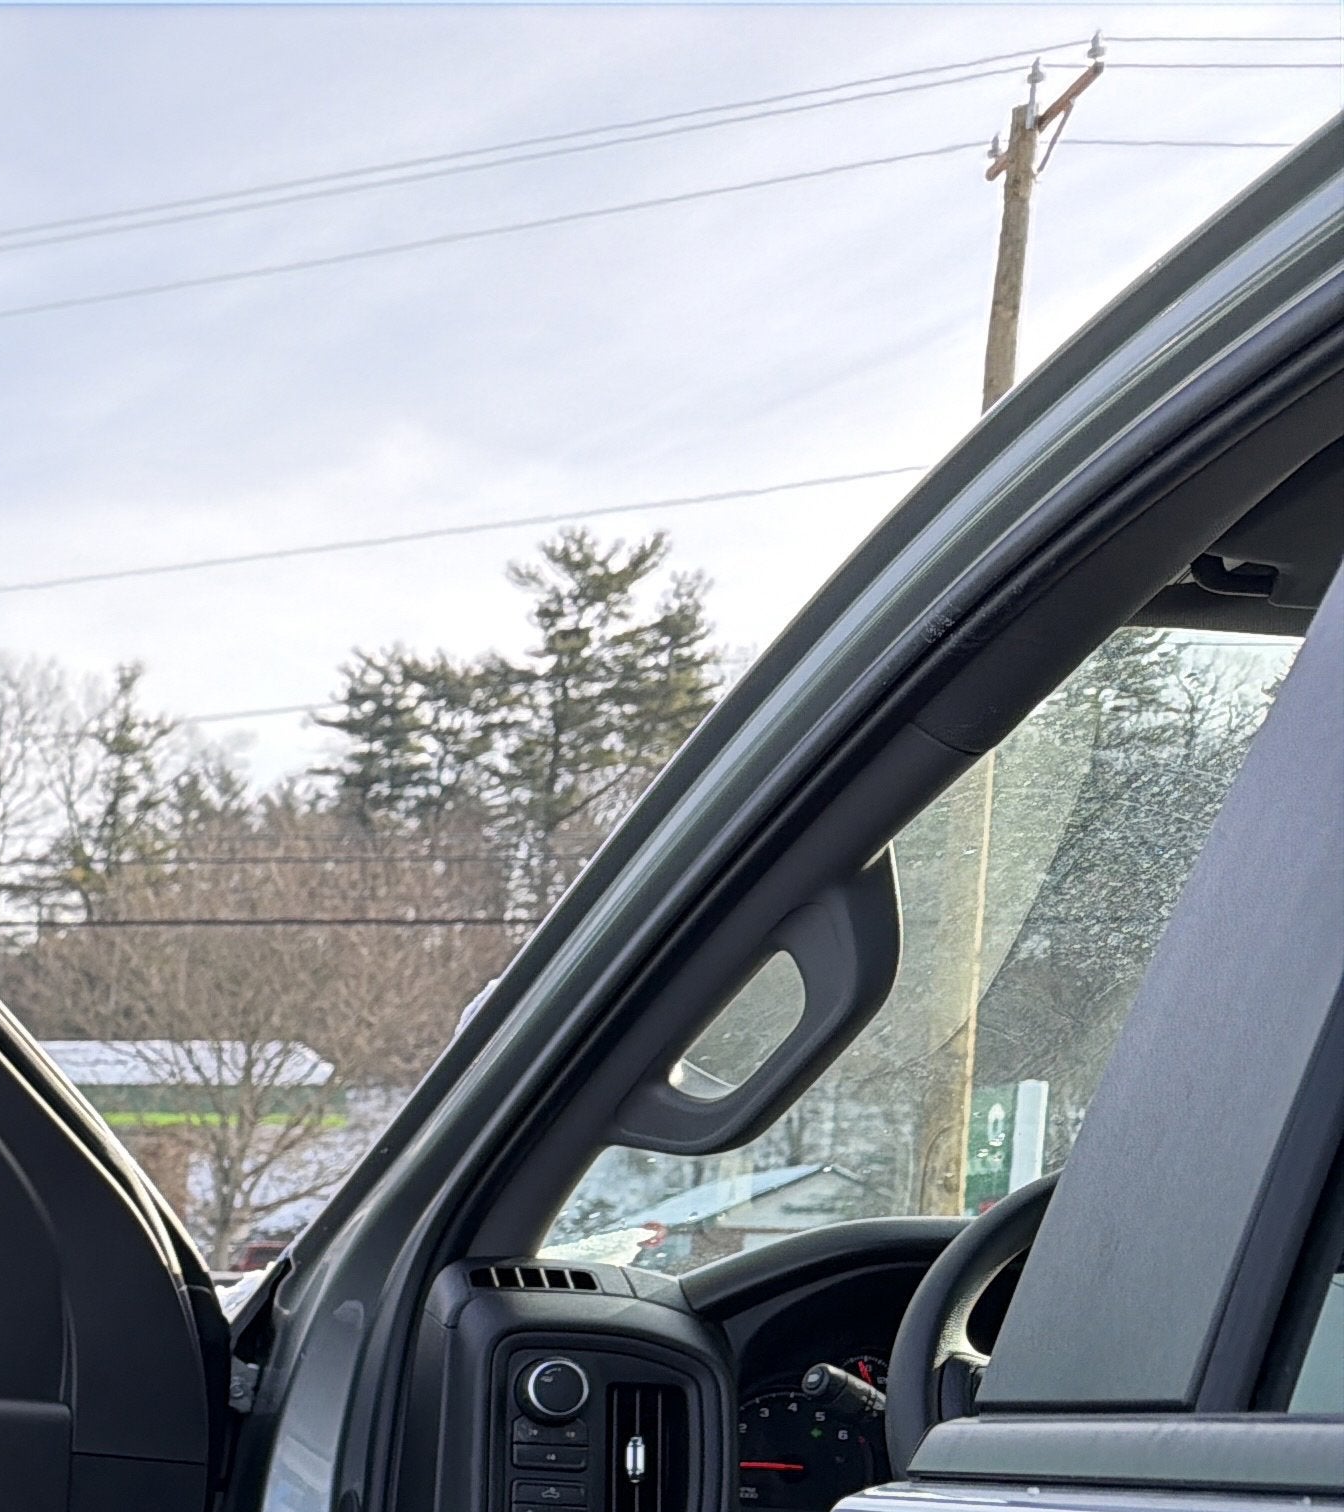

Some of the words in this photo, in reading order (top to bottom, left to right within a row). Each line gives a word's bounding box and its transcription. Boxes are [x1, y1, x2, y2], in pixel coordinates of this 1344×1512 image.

[759, 1407, 770, 1418] 3
[815, 1411, 826, 1422] 5
[837, 1430, 849, 1441] 6
